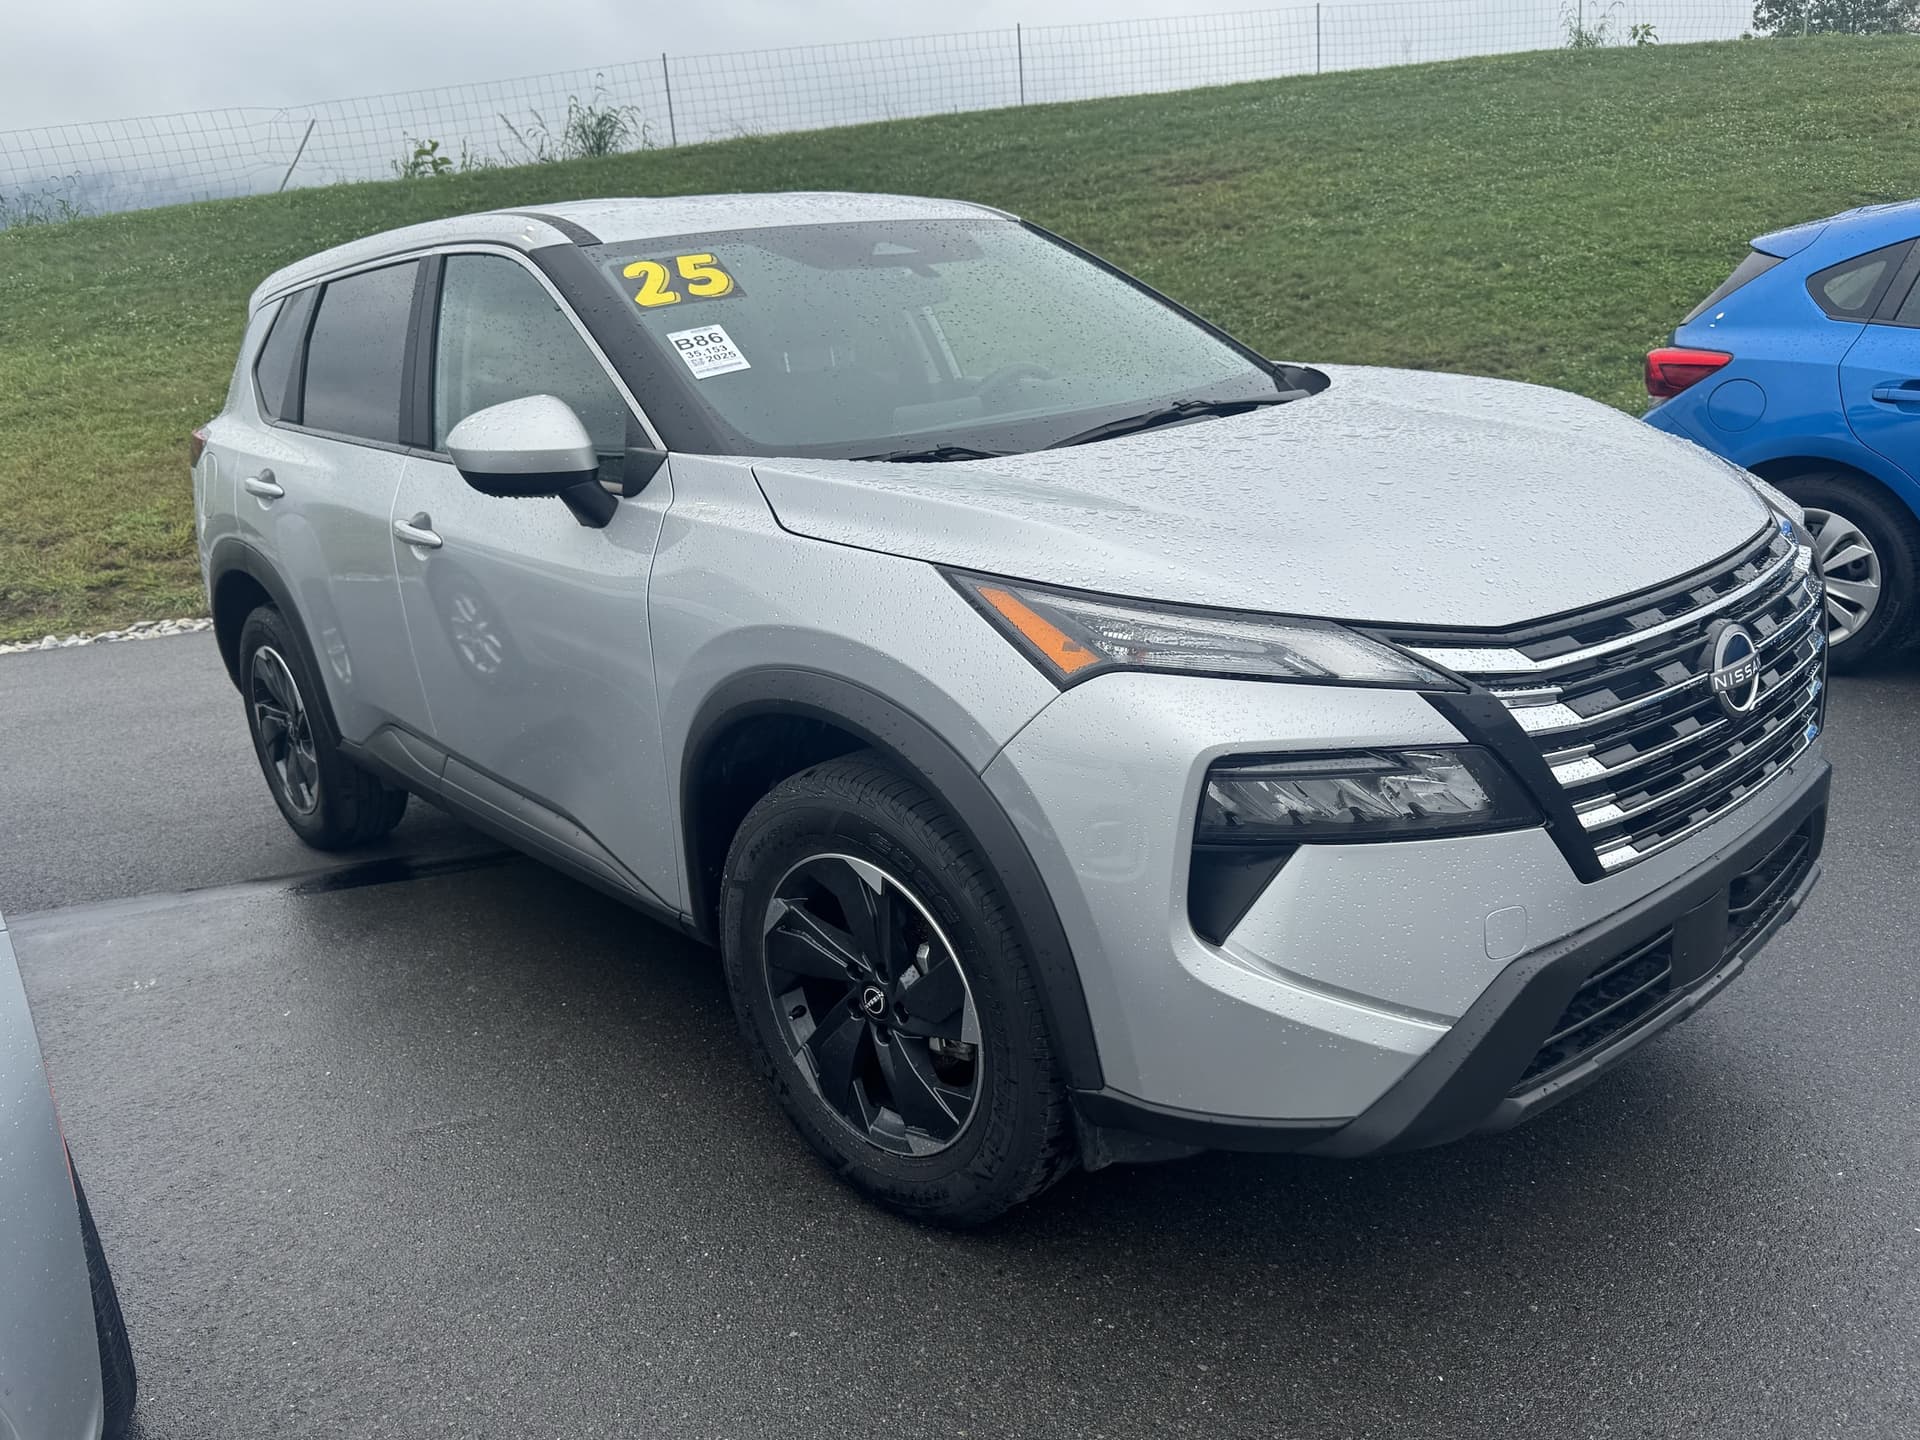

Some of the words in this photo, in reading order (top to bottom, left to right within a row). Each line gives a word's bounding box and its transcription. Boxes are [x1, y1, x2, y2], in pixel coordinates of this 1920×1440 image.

[623, 253, 734, 307] 25
[675, 332, 723, 350] B86
[705, 351, 737, 362] 2025
